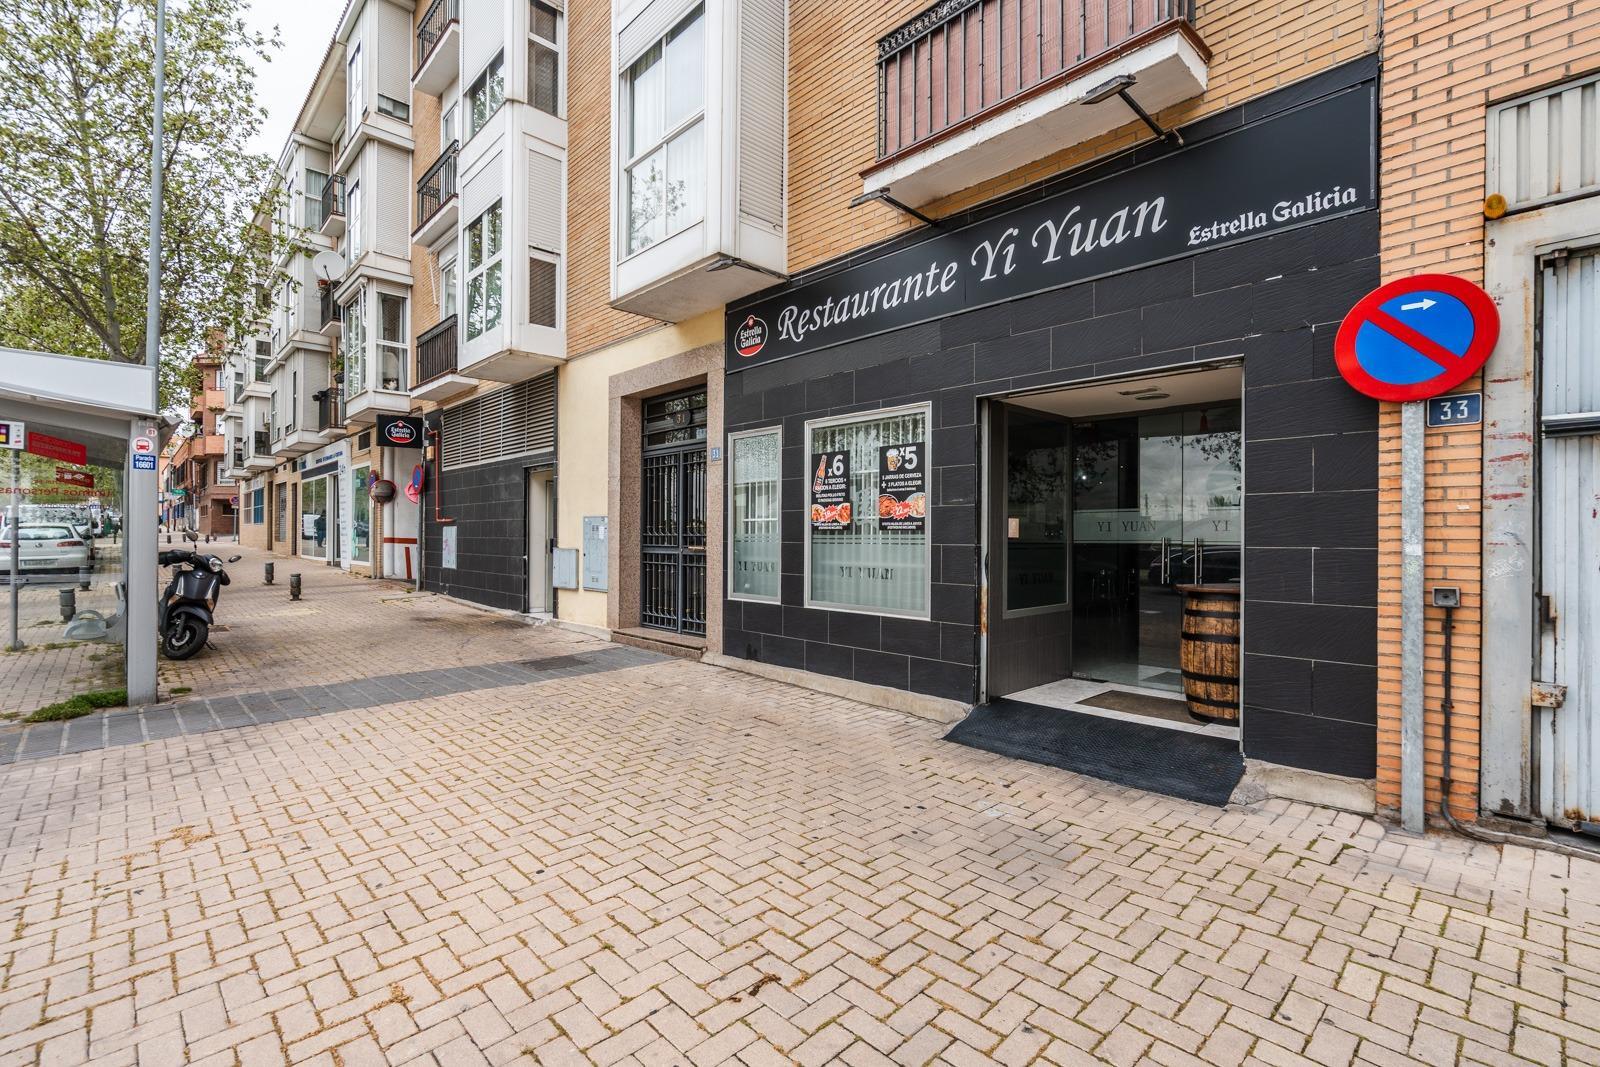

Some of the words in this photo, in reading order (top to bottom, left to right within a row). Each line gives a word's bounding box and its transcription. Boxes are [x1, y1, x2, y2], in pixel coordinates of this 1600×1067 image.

[1187, 211, 1269, 246] Estrella
[1272, 185, 1358, 222] Galicia
[777, 260, 959, 343] Restaurante
[970, 227, 1020, 283] Yi
[1031, 195, 1169, 266] Yuan
[740, 326, 762, 339] Estrella
[740, 336, 761, 348] Galicia
[1440, 400, 1469, 421] 33
[390, 426, 411, 434] Estrella
[135, 461, 154, 469] 16601
[1097, 520, 1112, 533] YI
[1122, 520, 1157, 533] YUAN
[1211, 520, 1232, 532] YI
